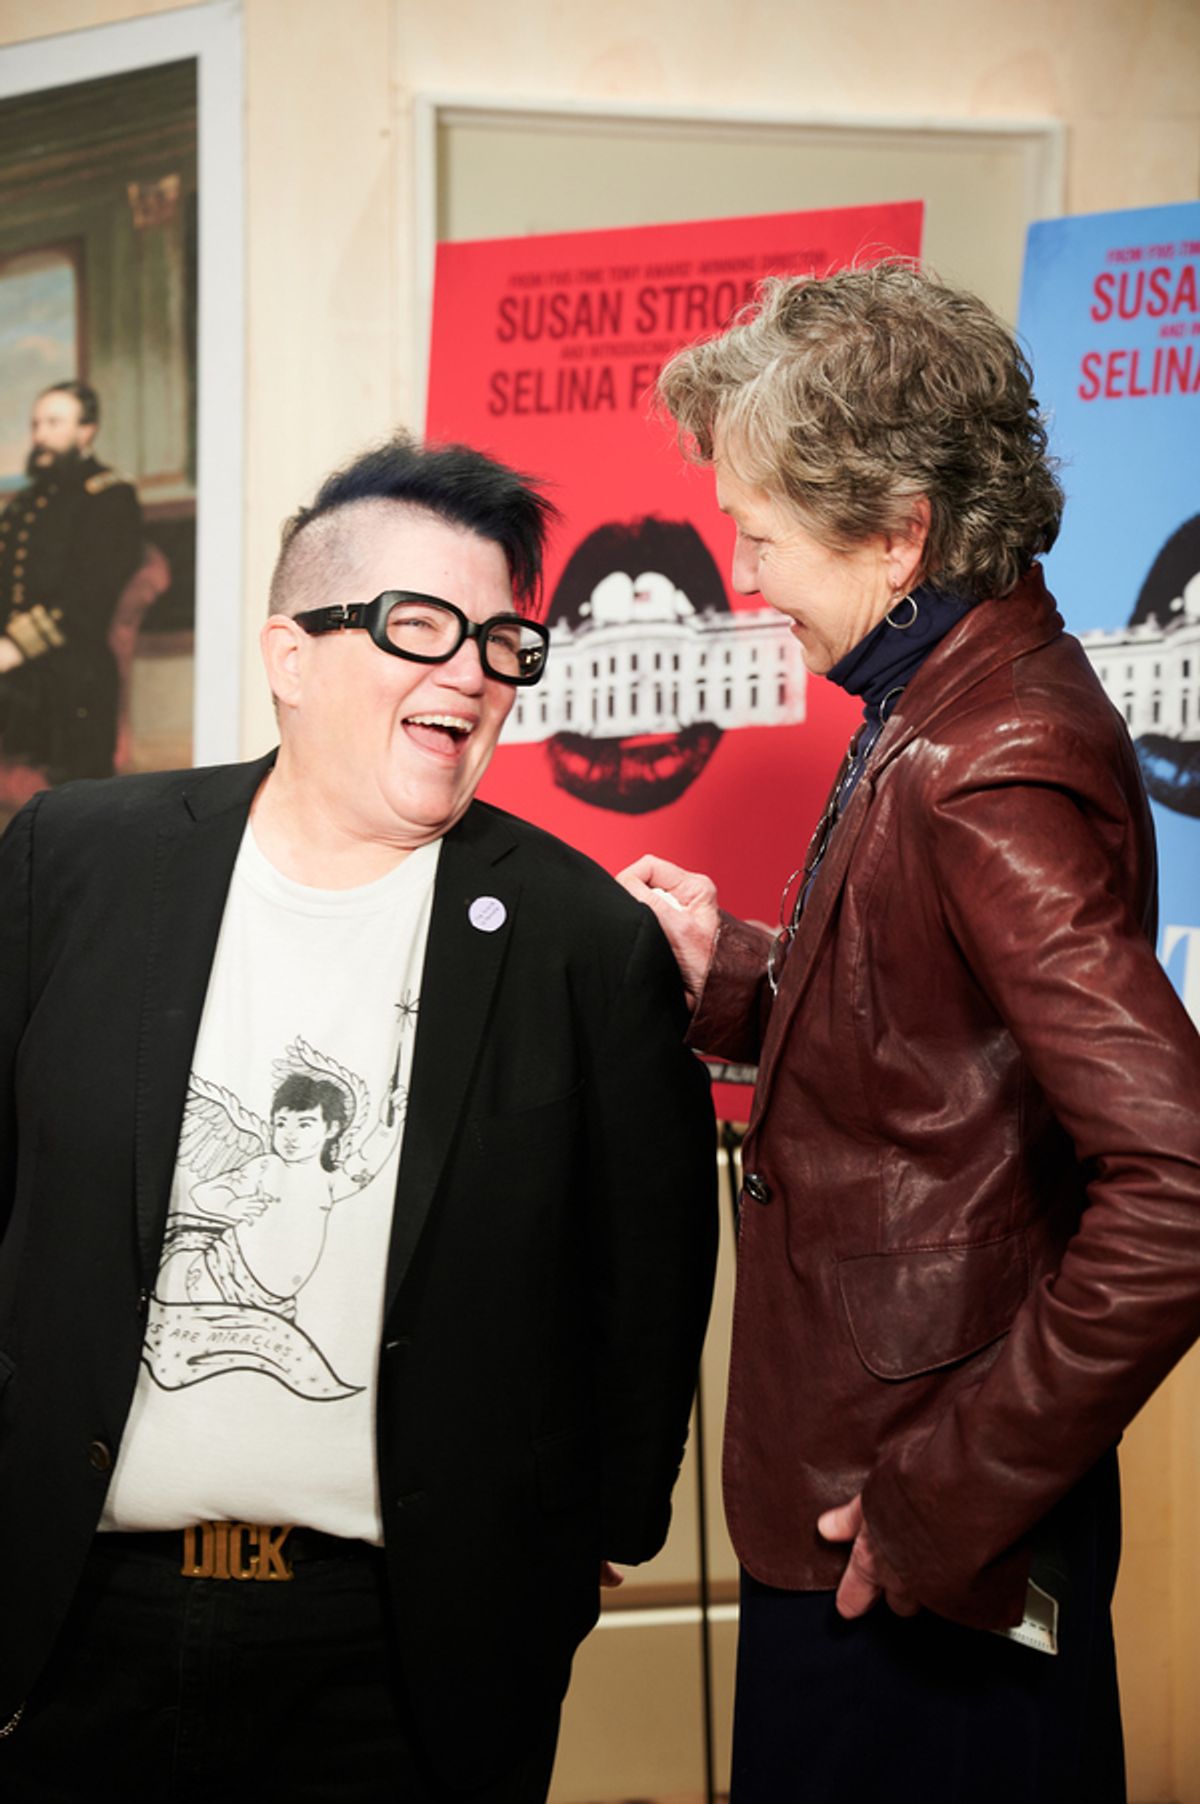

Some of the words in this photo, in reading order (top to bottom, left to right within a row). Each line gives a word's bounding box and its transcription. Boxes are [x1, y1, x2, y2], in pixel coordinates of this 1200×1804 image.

[495, 288, 623, 343] SUSAN
[634, 279, 758, 335] STRO
[1091, 265, 1200, 323] SUSA
[487, 363, 618, 417] SELINA
[169, 1327, 201, 1343] ARE
[181, 1520, 295, 1581] DICK
